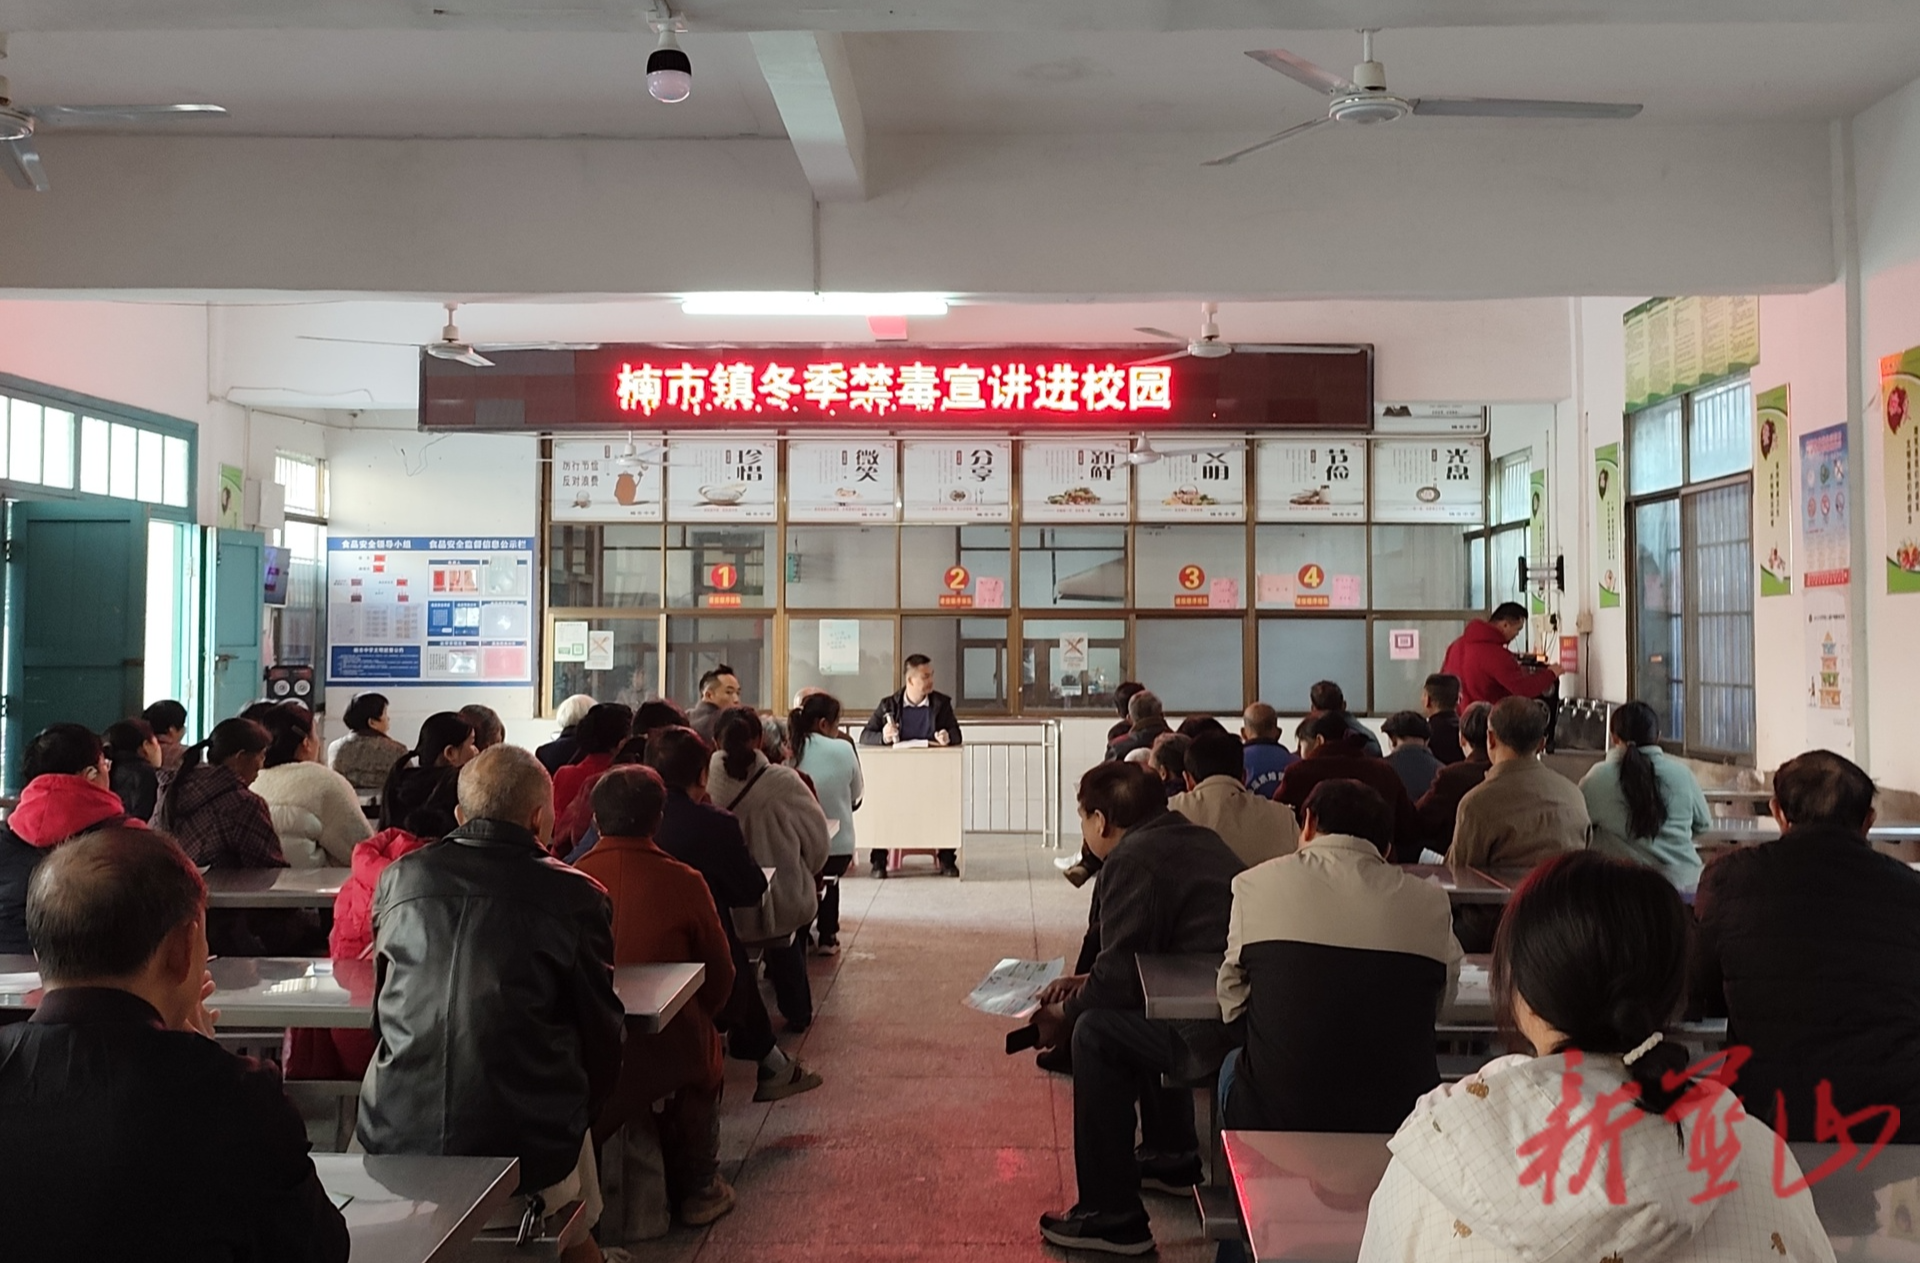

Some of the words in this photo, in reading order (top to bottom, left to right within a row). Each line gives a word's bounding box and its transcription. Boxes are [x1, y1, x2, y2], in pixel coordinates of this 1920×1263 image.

[617, 361, 1172, 415] 楠市镇冬季禁毒宣讲进校园
[855, 449, 879, 482] 微笑
[969, 449, 995, 482] 分享
[562, 475, 599, 487] 反对浪费
[341, 539, 412, 550] 食品安全领导小组
[429, 539, 527, 550] 食品安全监督信息公示栏
[718, 566, 729, 588] 1
[949, 567, 965, 589] 2
[1184, 567, 1200, 588] 3
[1303, 566, 1320, 587] 4
